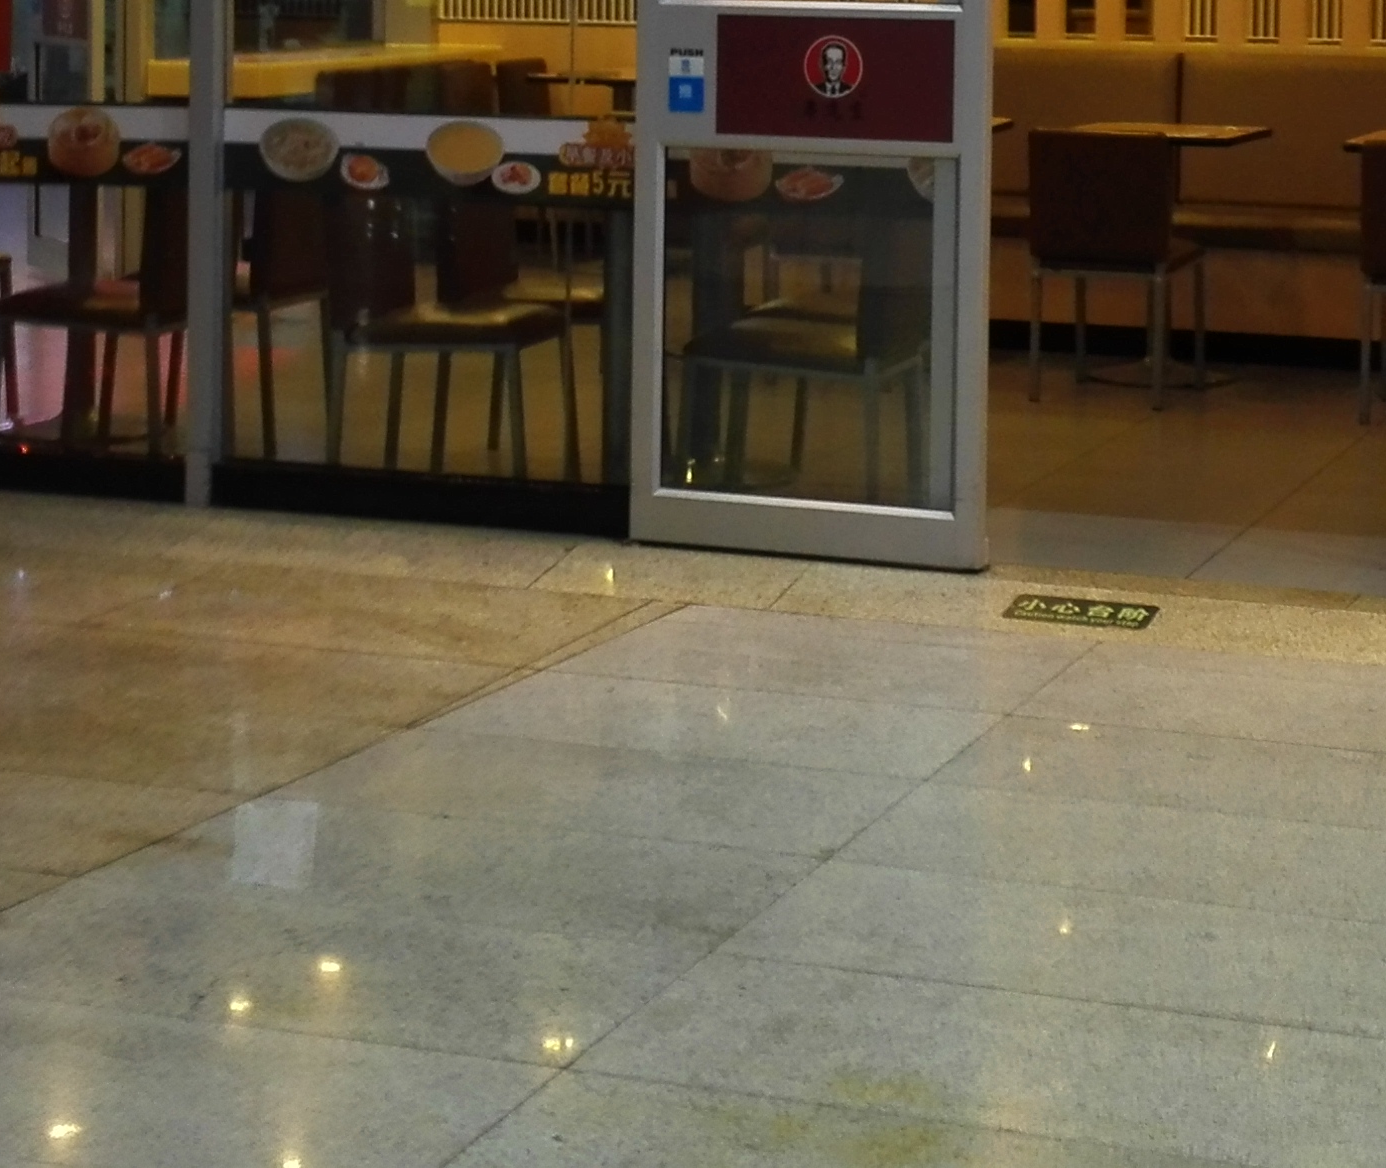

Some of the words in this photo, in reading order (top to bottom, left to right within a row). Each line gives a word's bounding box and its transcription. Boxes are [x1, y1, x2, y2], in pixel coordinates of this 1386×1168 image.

[670, 47, 705, 57] PUSH
[1017, 598, 1151, 622] 小心台阶
